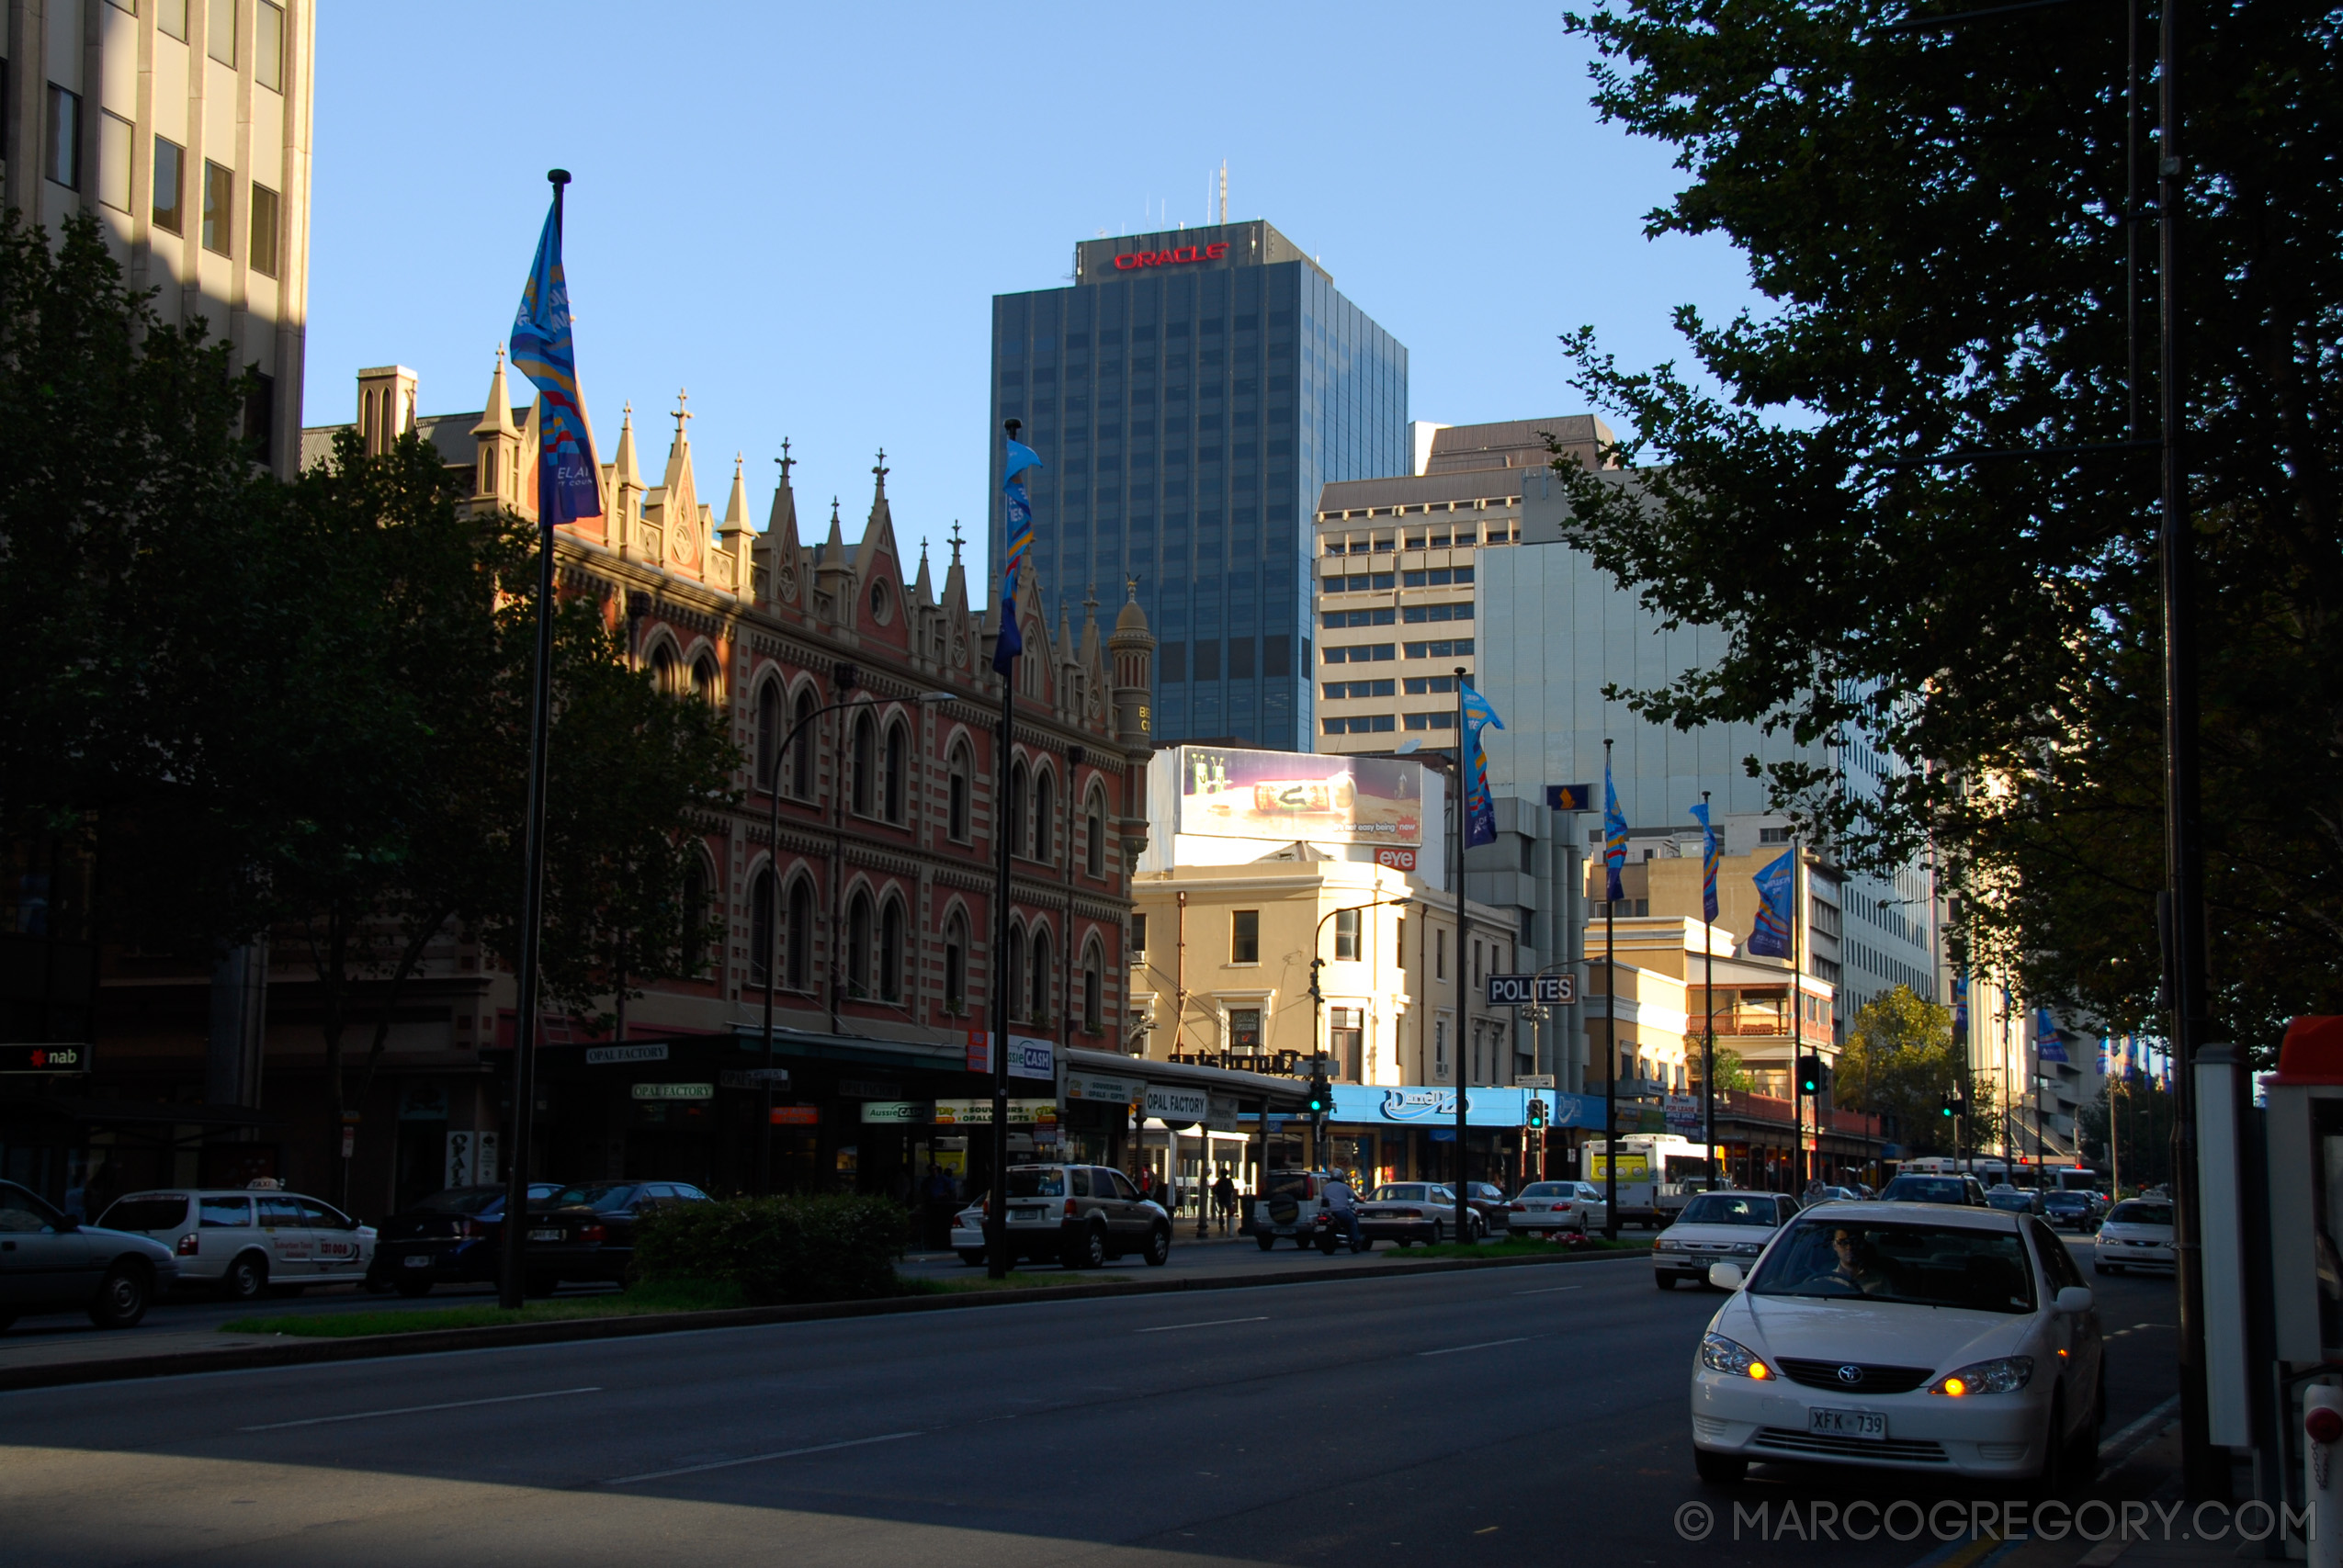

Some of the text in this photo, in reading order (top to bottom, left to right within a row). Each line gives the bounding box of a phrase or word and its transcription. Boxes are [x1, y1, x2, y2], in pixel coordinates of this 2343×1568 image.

[1115, 242, 1228, 270] ORACLE
[1345, 823, 1356, 831] not
[1357, 823, 1375, 834] easy
[1376, 821, 1396, 833] being
[1399, 823, 1416, 831] new
[1379, 851, 1414, 867] eye
[1492, 978, 1571, 1001] POLITES
[49, 1049, 77, 1064] nab
[588, 1045, 665, 1062] OPAL FACTORY
[1007, 1051, 1049, 1068] ssie CASH
[634, 1087, 710, 1097] OPAL FACTORY
[1147, 1091, 1168, 1111] OPAL
[1170, 1094, 1205, 1114] FACTORY
[869, 1108, 923, 1118] Aussie CASH
[1007, 1114, 1030, 1122] IFTS
[321, 1244, 347, 1255] 131 008
